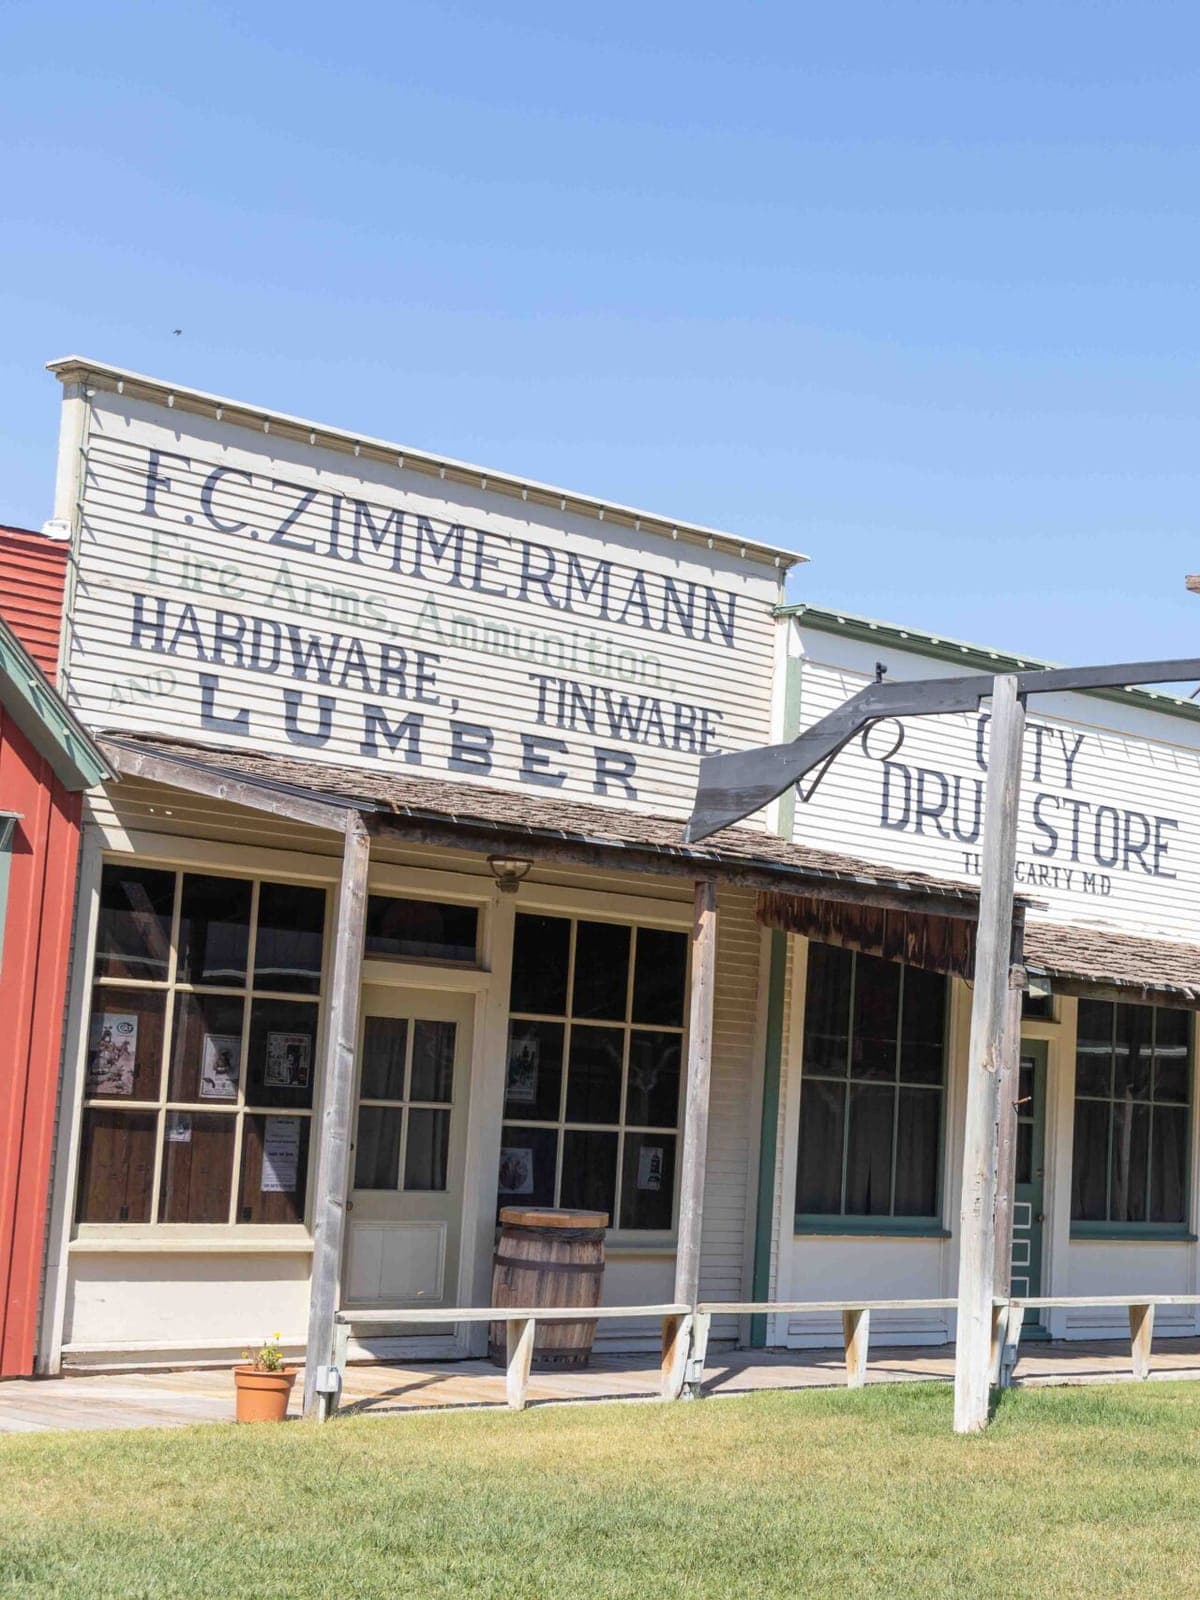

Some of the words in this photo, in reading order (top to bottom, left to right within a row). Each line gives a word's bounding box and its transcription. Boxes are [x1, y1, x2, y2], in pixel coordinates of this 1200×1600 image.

[147, 531, 243, 601] Fire
[107, 669, 177, 711] AND
[199, 673, 640, 801] LUMBER
[976, 713, 1085, 791] CTY
[879, 761, 985, 845] DRU
[1031, 791, 1180, 880] STORE
